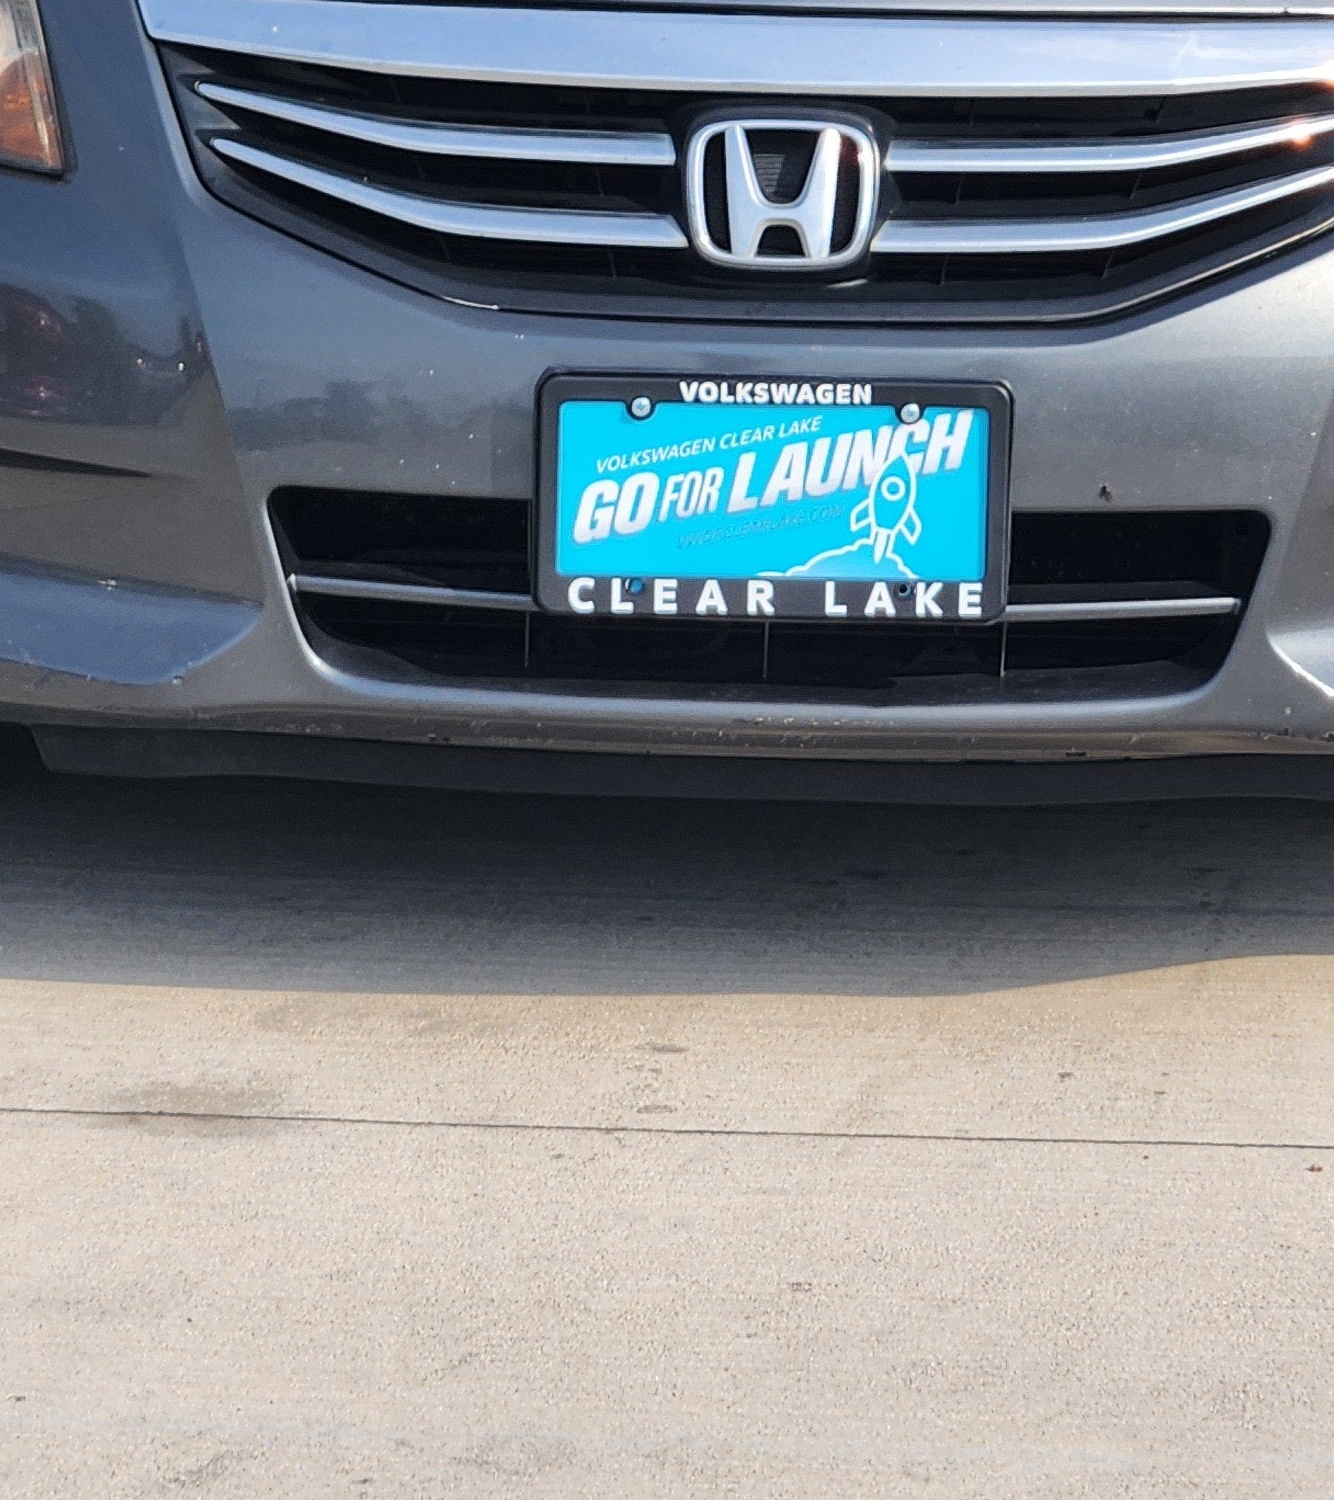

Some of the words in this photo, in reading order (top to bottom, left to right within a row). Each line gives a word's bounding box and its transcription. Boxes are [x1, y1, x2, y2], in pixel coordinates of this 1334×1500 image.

[679, 381, 873, 405] VOLKSWAGEN
[596, 436, 717, 473] VOLKSWAGEN
[719, 423, 775, 451] CLEAR
[777, 415, 824, 439] LAKE
[573, 473, 660, 543] GO
[659, 467, 723, 521] FOR
[727, 409, 974, 513] LAUNCH
[567, 577, 776, 615] CLEAR
[824, 581, 984, 617] LAKE
